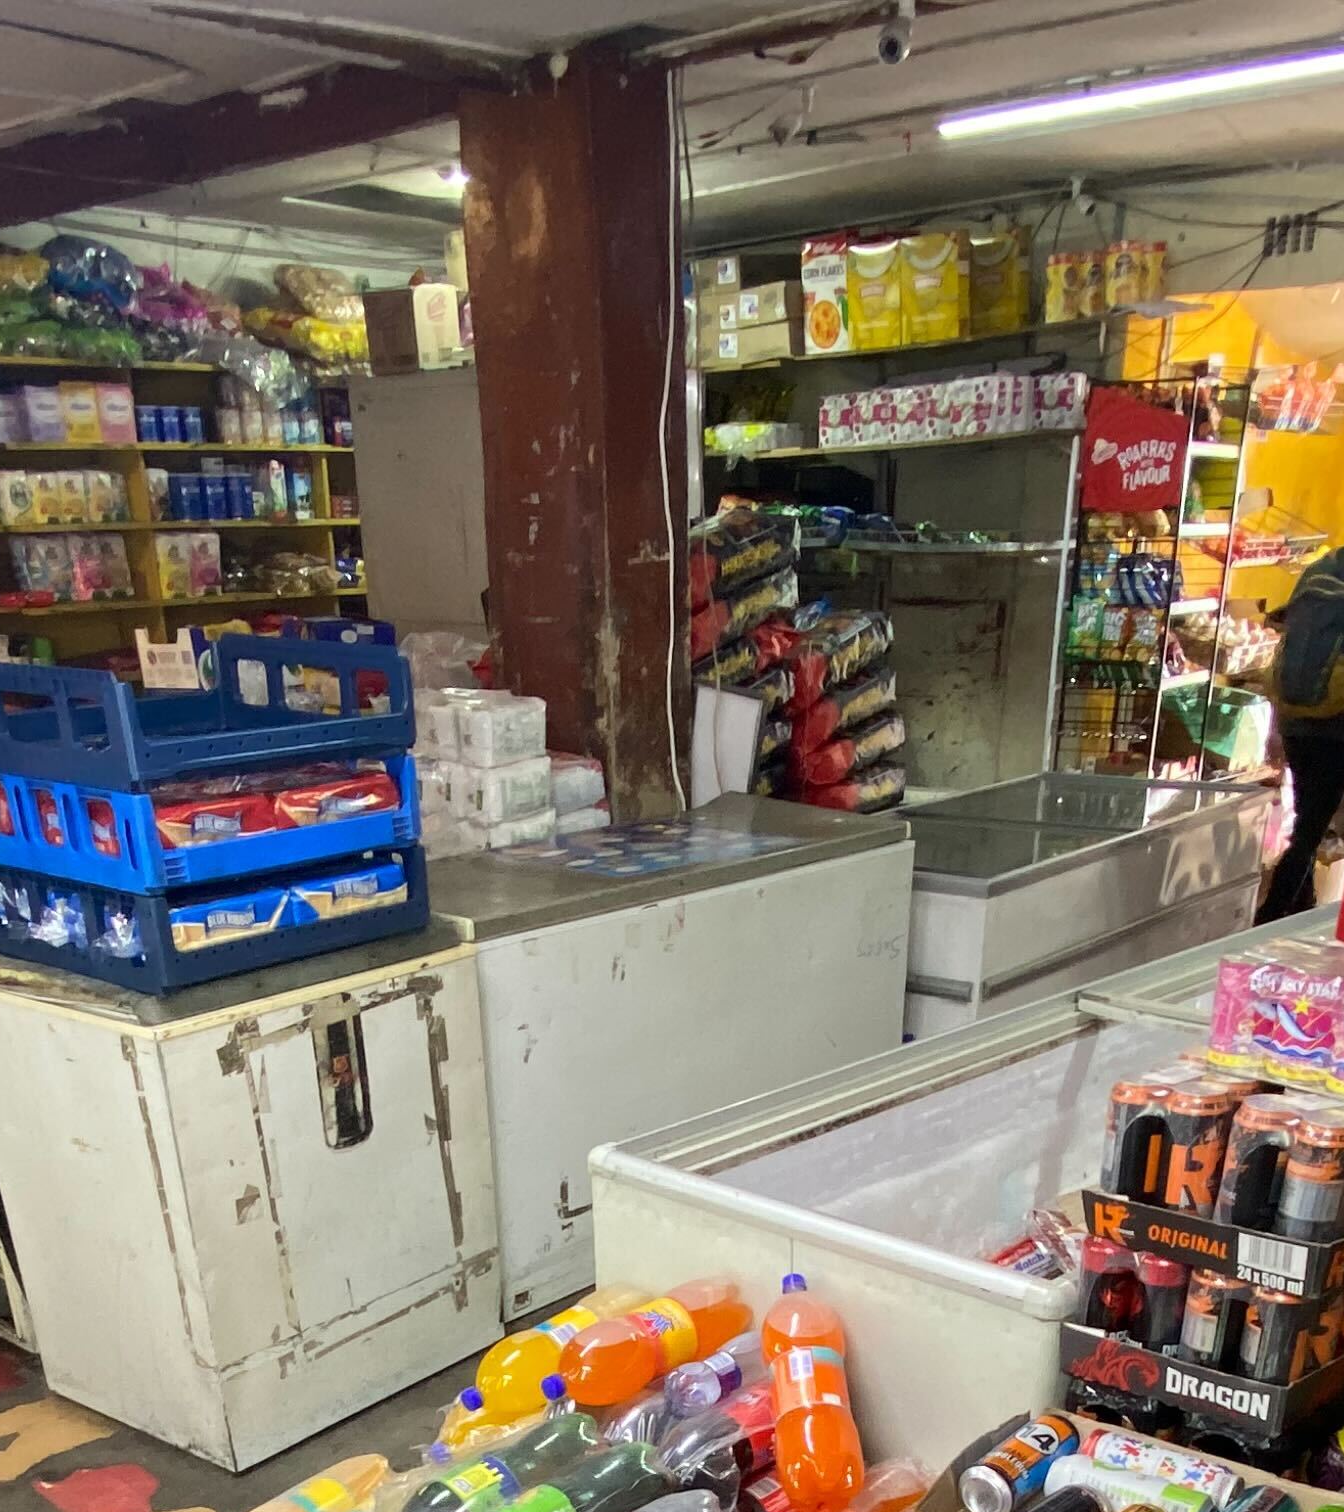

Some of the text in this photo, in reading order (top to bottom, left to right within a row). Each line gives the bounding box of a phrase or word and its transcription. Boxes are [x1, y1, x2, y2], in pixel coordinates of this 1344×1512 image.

[1122, 465, 1171, 491] FLAVOUR
[1148, 1224, 1228, 1261] ORIGINAL
[1236, 1265, 1253, 1283] 24
[1260, 1273, 1286, 1292] 500
[1287, 1279, 1305, 1297] ml
[1165, 1365, 1271, 1422] DRAGON
